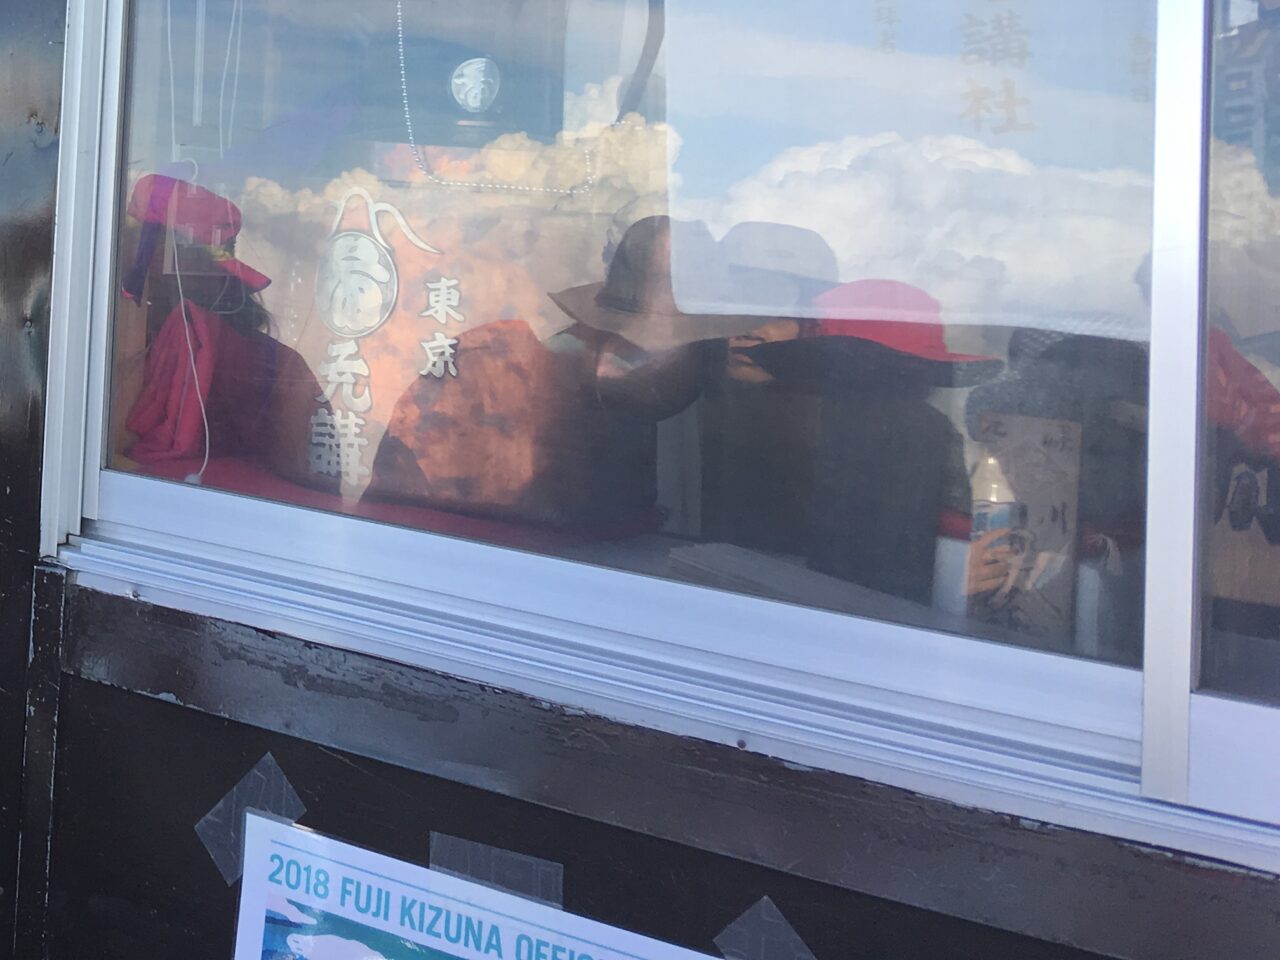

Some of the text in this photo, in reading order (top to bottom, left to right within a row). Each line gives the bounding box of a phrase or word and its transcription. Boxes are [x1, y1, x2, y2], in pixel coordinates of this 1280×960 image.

[420, 276, 465, 379] 東京
[268, 853, 331, 900] 2018
[340, 876, 391, 922] FUJI
[400, 895, 504, 959] KIZUNA
